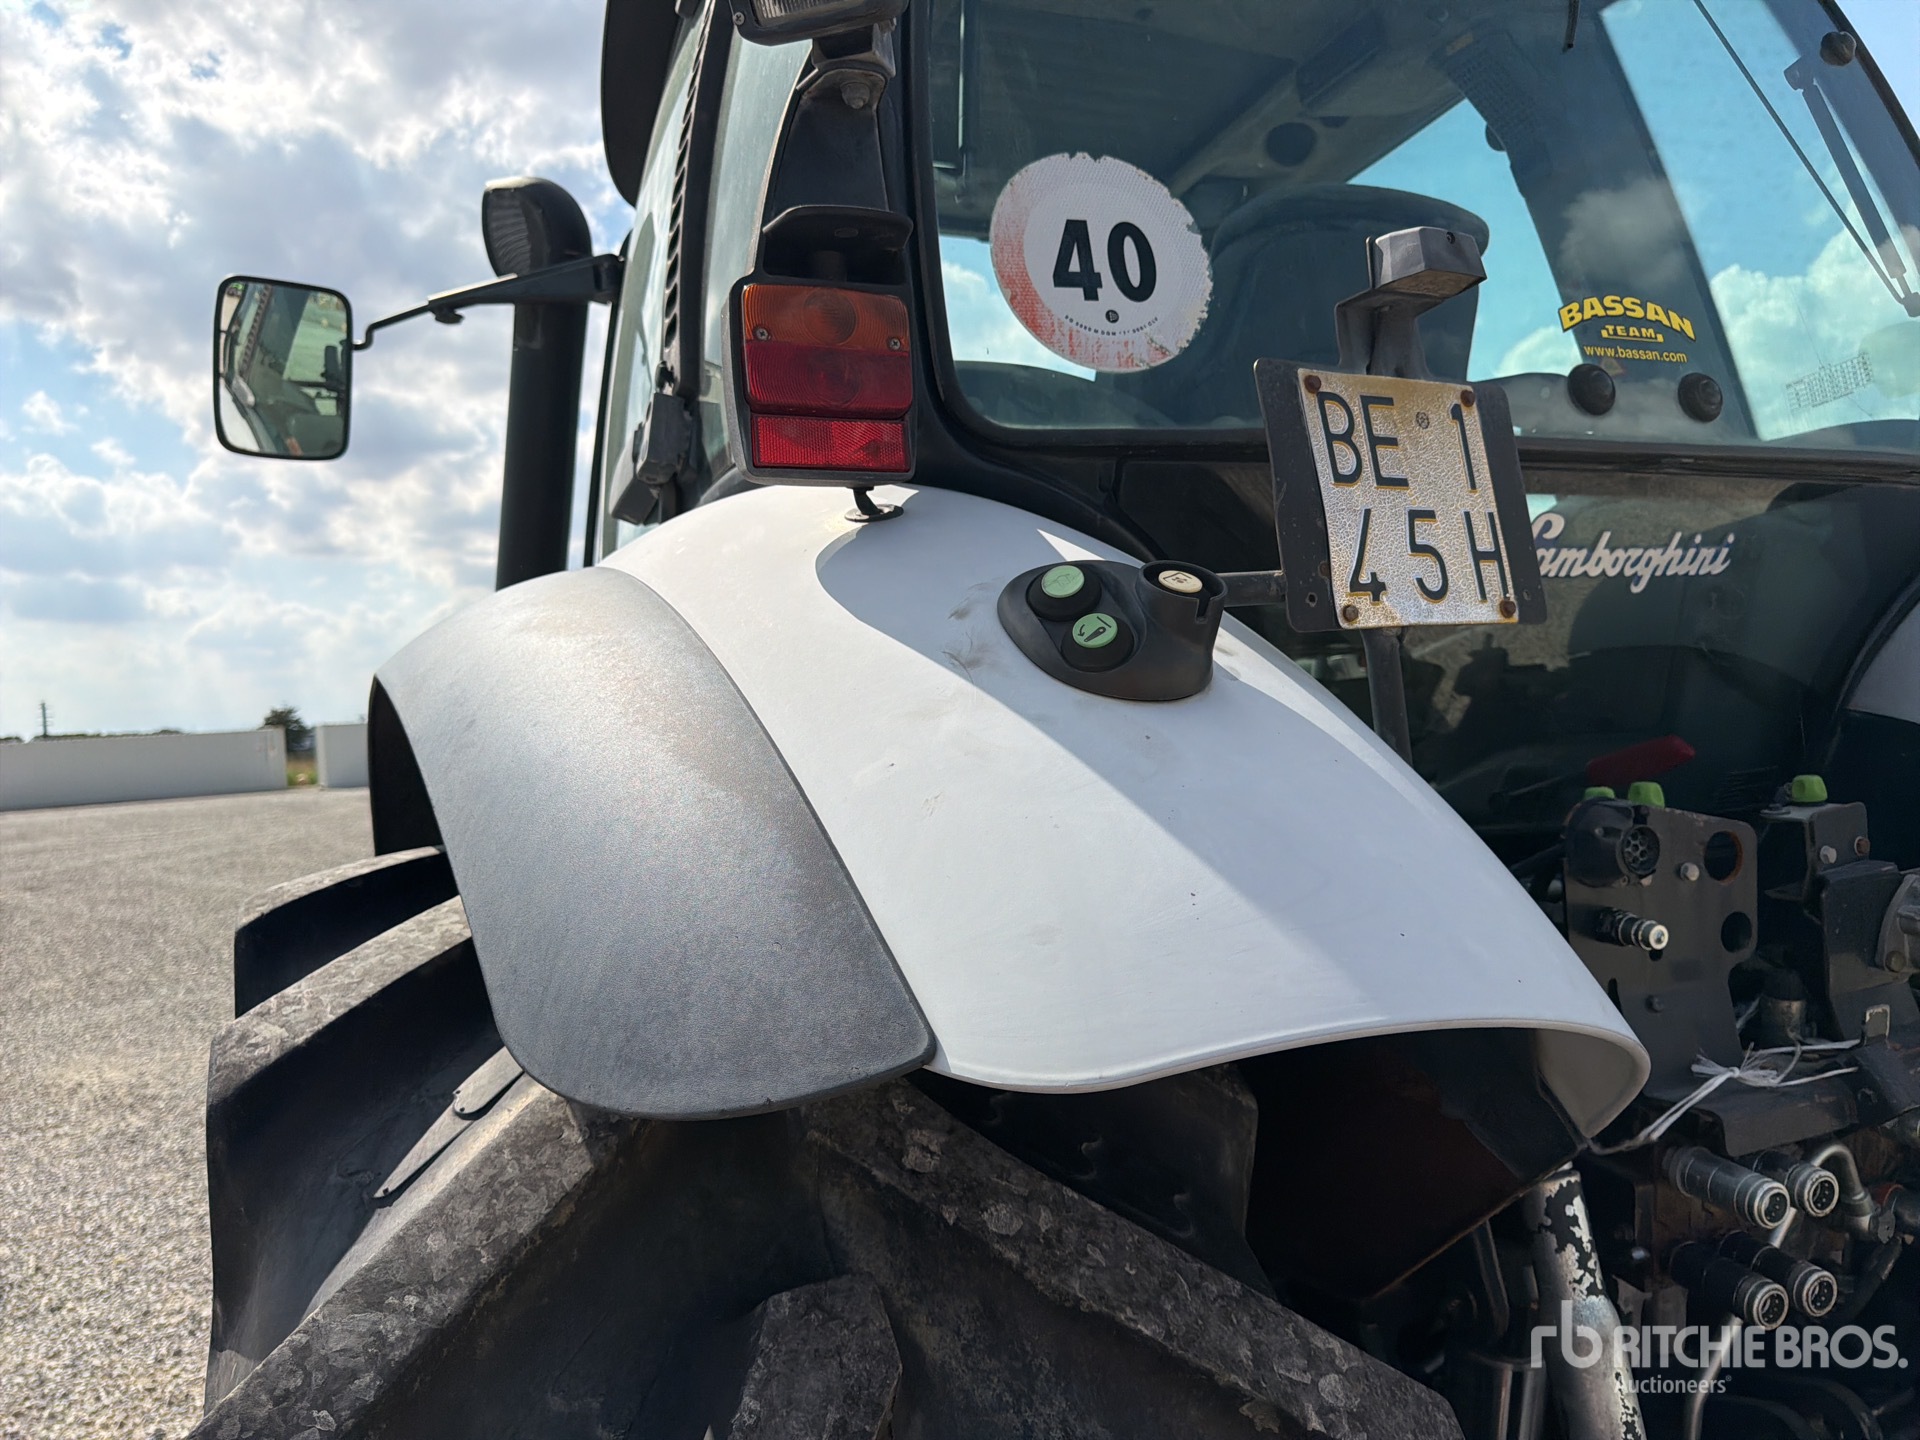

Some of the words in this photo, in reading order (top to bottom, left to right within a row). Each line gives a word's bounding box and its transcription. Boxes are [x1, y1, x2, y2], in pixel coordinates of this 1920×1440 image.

[1053, 219, 1156, 303] 40
[1558, 294, 1696, 341] BASSAN
[1604, 324, 1656, 339] TEAM
[1583, 345, 1688, 363] www.bassan.com
[1317, 391, 1410, 488] BE
[1450, 403, 1478, 493] 1
